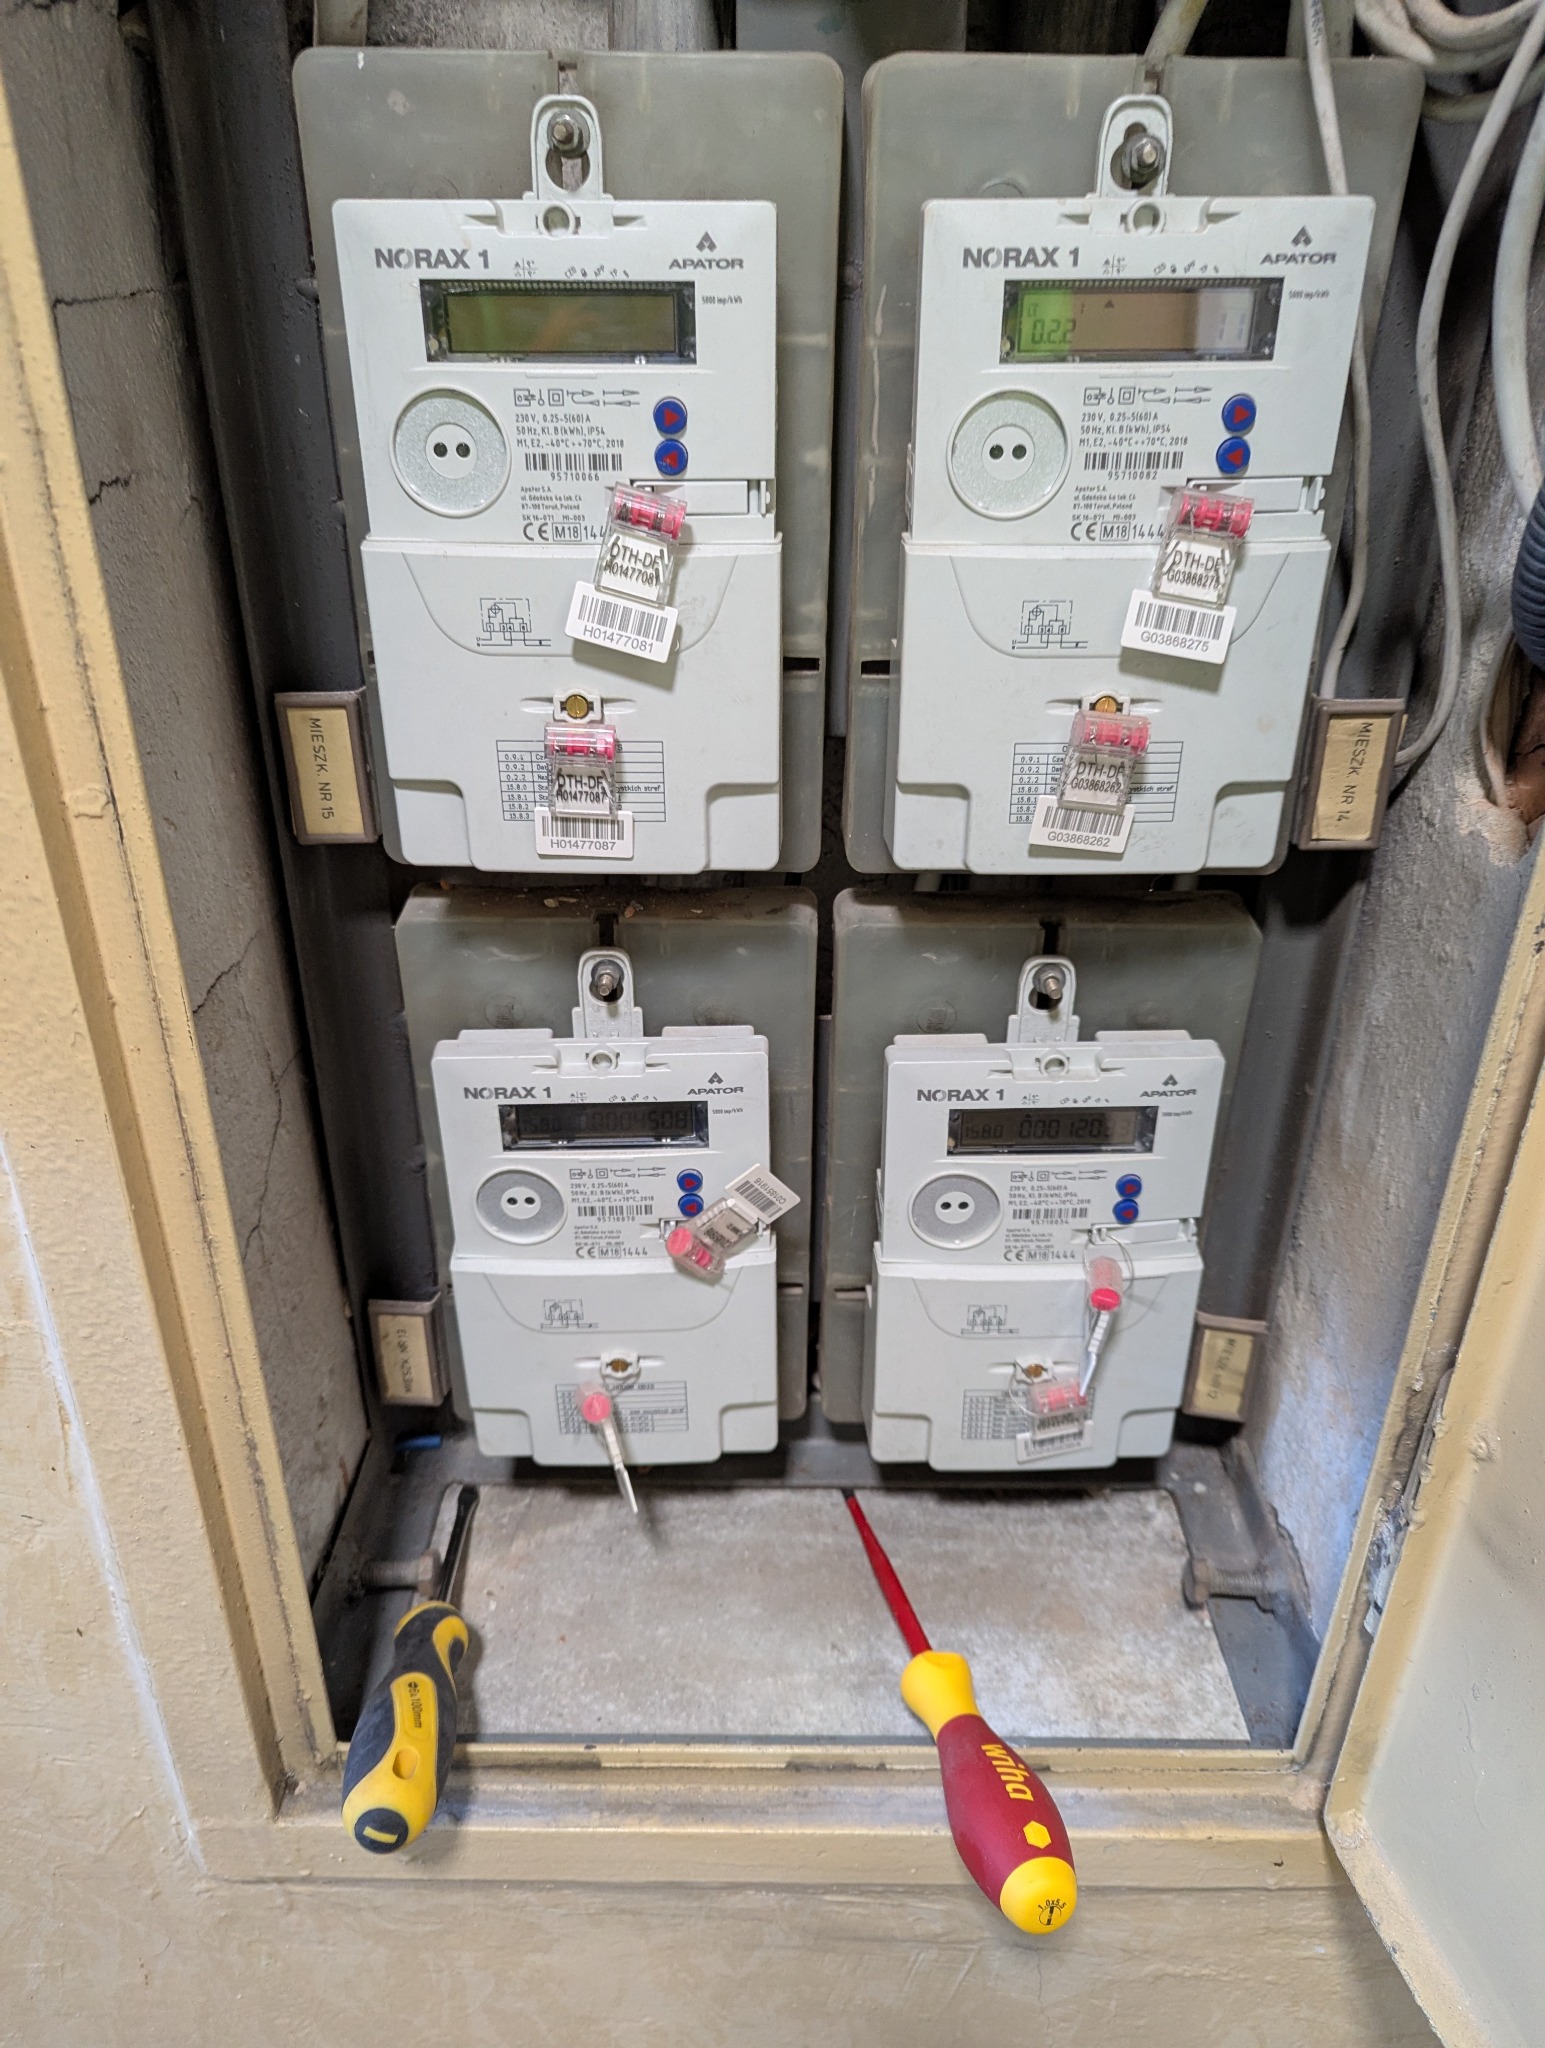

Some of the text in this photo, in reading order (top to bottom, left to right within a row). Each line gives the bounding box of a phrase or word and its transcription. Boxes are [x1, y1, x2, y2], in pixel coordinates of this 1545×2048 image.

[374, 248, 470, 269] NORAX
[478, 249, 489, 269] 1
[962, 246, 1060, 269] NORAX
[1069, 246, 1080, 268] 1
[1259, 252, 1337, 265] APATOR
[669, 258, 744, 270] APATOR
[515, 413, 592, 424] 230 V, 0.25-5(60) A
[1081, 412, 1158, 423] 230 V, 0.25-5(60) A
[606, 439, 625, 448] 2018
[1169, 437, 1188, 448] 2018
[550, 472, 600, 481] 95710066
[1107, 470, 1158, 481] 95710082
[555, 525, 579, 539] M18
[1102, 525, 1127, 539] M18
[1132, 524, 1165, 539] 1444
[583, 624, 654, 653] H01477081
[1140, 630, 1209, 652] G03868275
[1020, 756, 1040, 764] 0.9.1
[309, 717, 335, 820] MIESZK. NR 15
[1020, 766, 1040, 774] 0.9.2
[1017, 786, 1039, 794] 15.8.0
[1340, 785, 1357, 805] NR
[1337, 810, 1350, 822] 14
[550, 839, 616, 850] H01477087
[1047, 831, 1110, 847] G03868262
[463, 1086, 552, 1100] NORAX 1
[686, 1086, 745, 1096] APATOR
[916, 1089, 1005, 1102] NORAX 1
[1139, 1089, 1198, 1098] APATOR
[600, 1248, 620, 1256] M18
[623, 1247, 648, 1256] 1444
[1050, 1250, 1076, 1259] 1444
[980, 1743, 1035, 1802] wiha
[1037, 1898, 1067, 1911] 1.0x5.5
